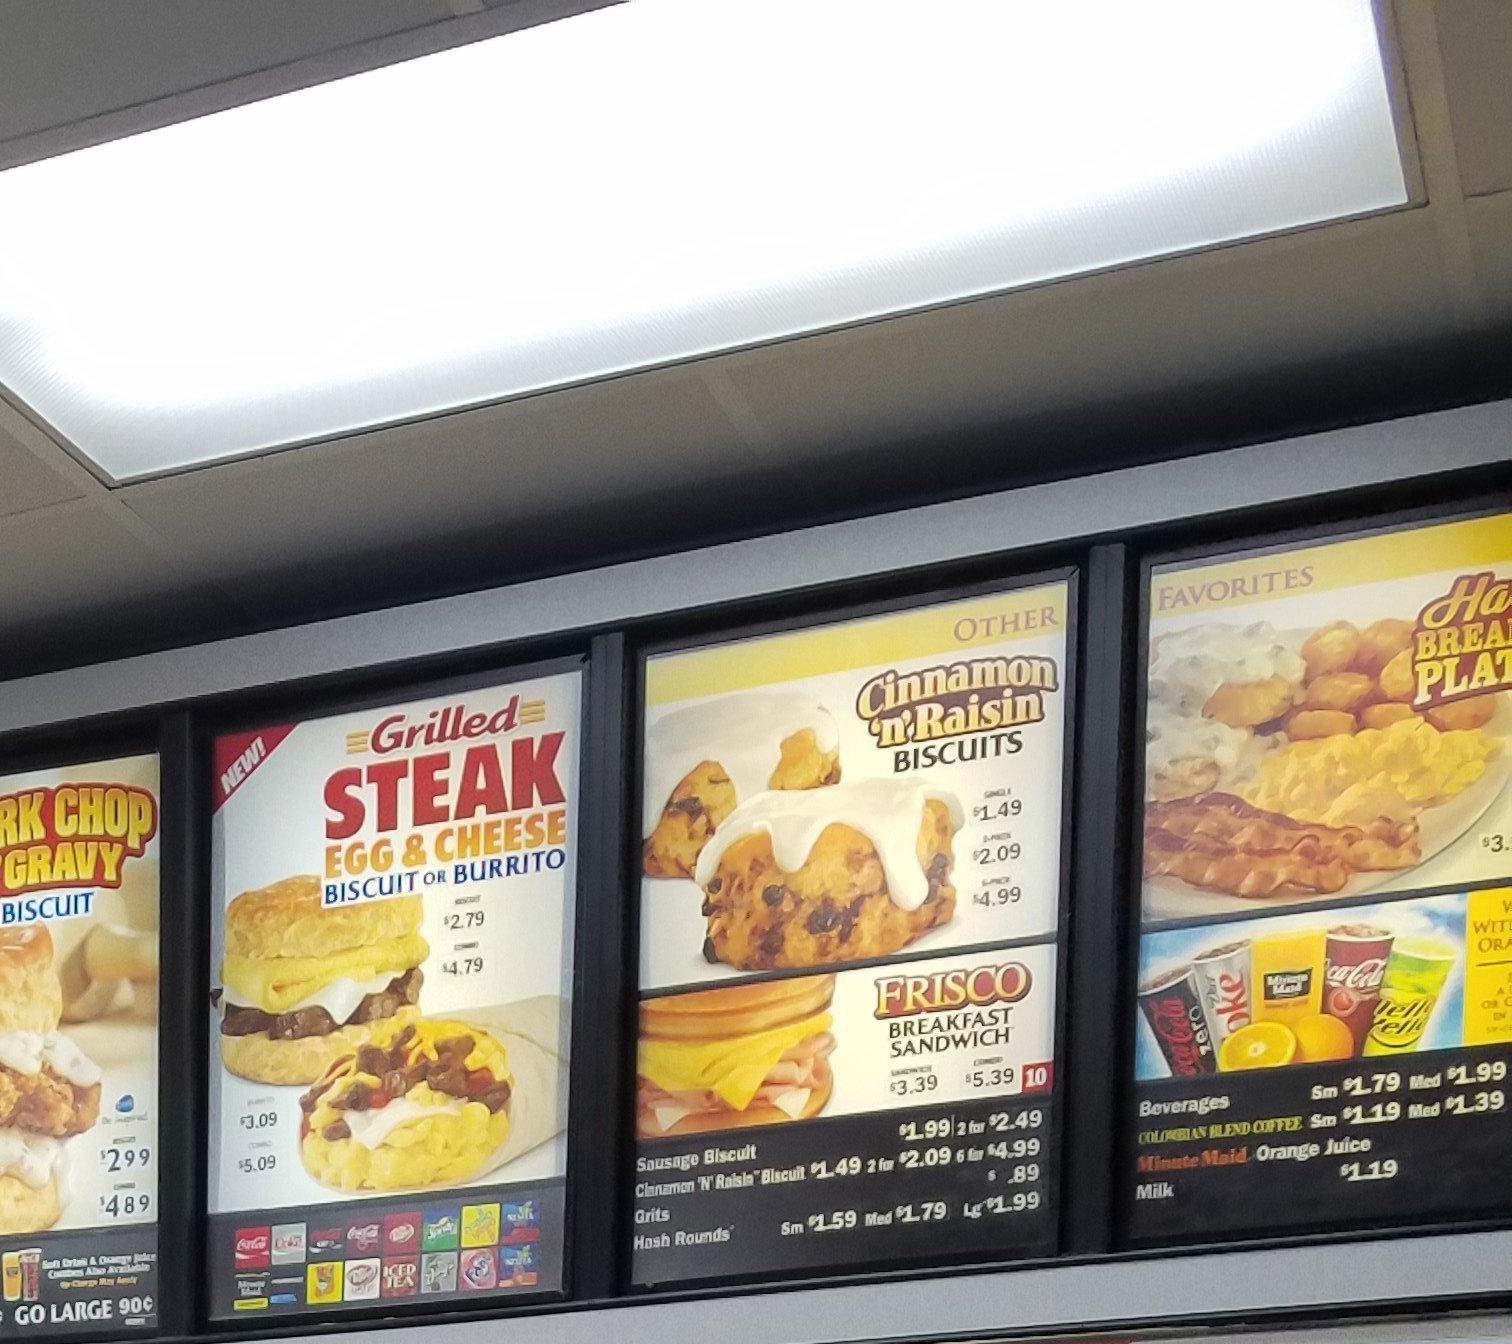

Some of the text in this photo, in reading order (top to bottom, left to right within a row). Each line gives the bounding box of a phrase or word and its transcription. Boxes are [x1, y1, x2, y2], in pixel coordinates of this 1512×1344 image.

[1158, 566, 1314, 611] FAVORITES
[954, 606, 1058, 642] OTHER
[858, 657, 1058, 719] Cinnamon
[371, 694, 520, 754] Grilled
[913, 688, 1042, 741] Raisin
[894, 730, 1023, 772] BISCUITS
[324, 731, 567, 840] STEAK
[54, 787, 154, 850] CHOP
[973, 800, 1022, 822] $1.49
[326, 809, 566, 879] EGG & CHEESE
[973, 843, 1021, 864] $2.09
[4, 841, 123, 890] GRAVY
[325, 848, 566, 905] BISCUIT BURRITO
[1, 891, 95, 925] BISCUIT
[973, 886, 1021, 907] $4.99
[444, 910, 484, 930] $2.79
[442, 957, 483, 974] $4.79
[876, 962, 1030, 1016] FRISCO
[889, 1007, 1013, 1038] BREAKFAST
[891, 1026, 1014, 1058] SANDWICH
[890, 1068, 1014, 1095] $3.39 $5.39
[1025, 1067, 1047, 1088] 10
[1139, 1061, 1507, 1118] Beverages Sm $1.79 $1.99
[1310, 1090, 1505, 1129] Sm $1.19 $1.39
[637, 1109, 1043, 1172] Sausage Biscuit $1.99 2 for $2.49
[1202, 1137, 1372, 1165] Maid Orange Juice
[239, 1155, 276, 1173] $5.09
[635, 1138, 1040, 1198] Cinnamon Biscuit $1.49 2 $2.09 6 $4.99
[1136, 1159, 1399, 1200] Milk $1.19
[633, 1191, 1040, 1250] Hash Rounds Sm $1.59 Med $1.79 $1.99
[634, 1207, 670, 1224] Grits
[15, 1304, 46, 1326] GO
[51, 1300, 113, 1323] LARGE
[119, 1295, 153, 1315] 90¢
